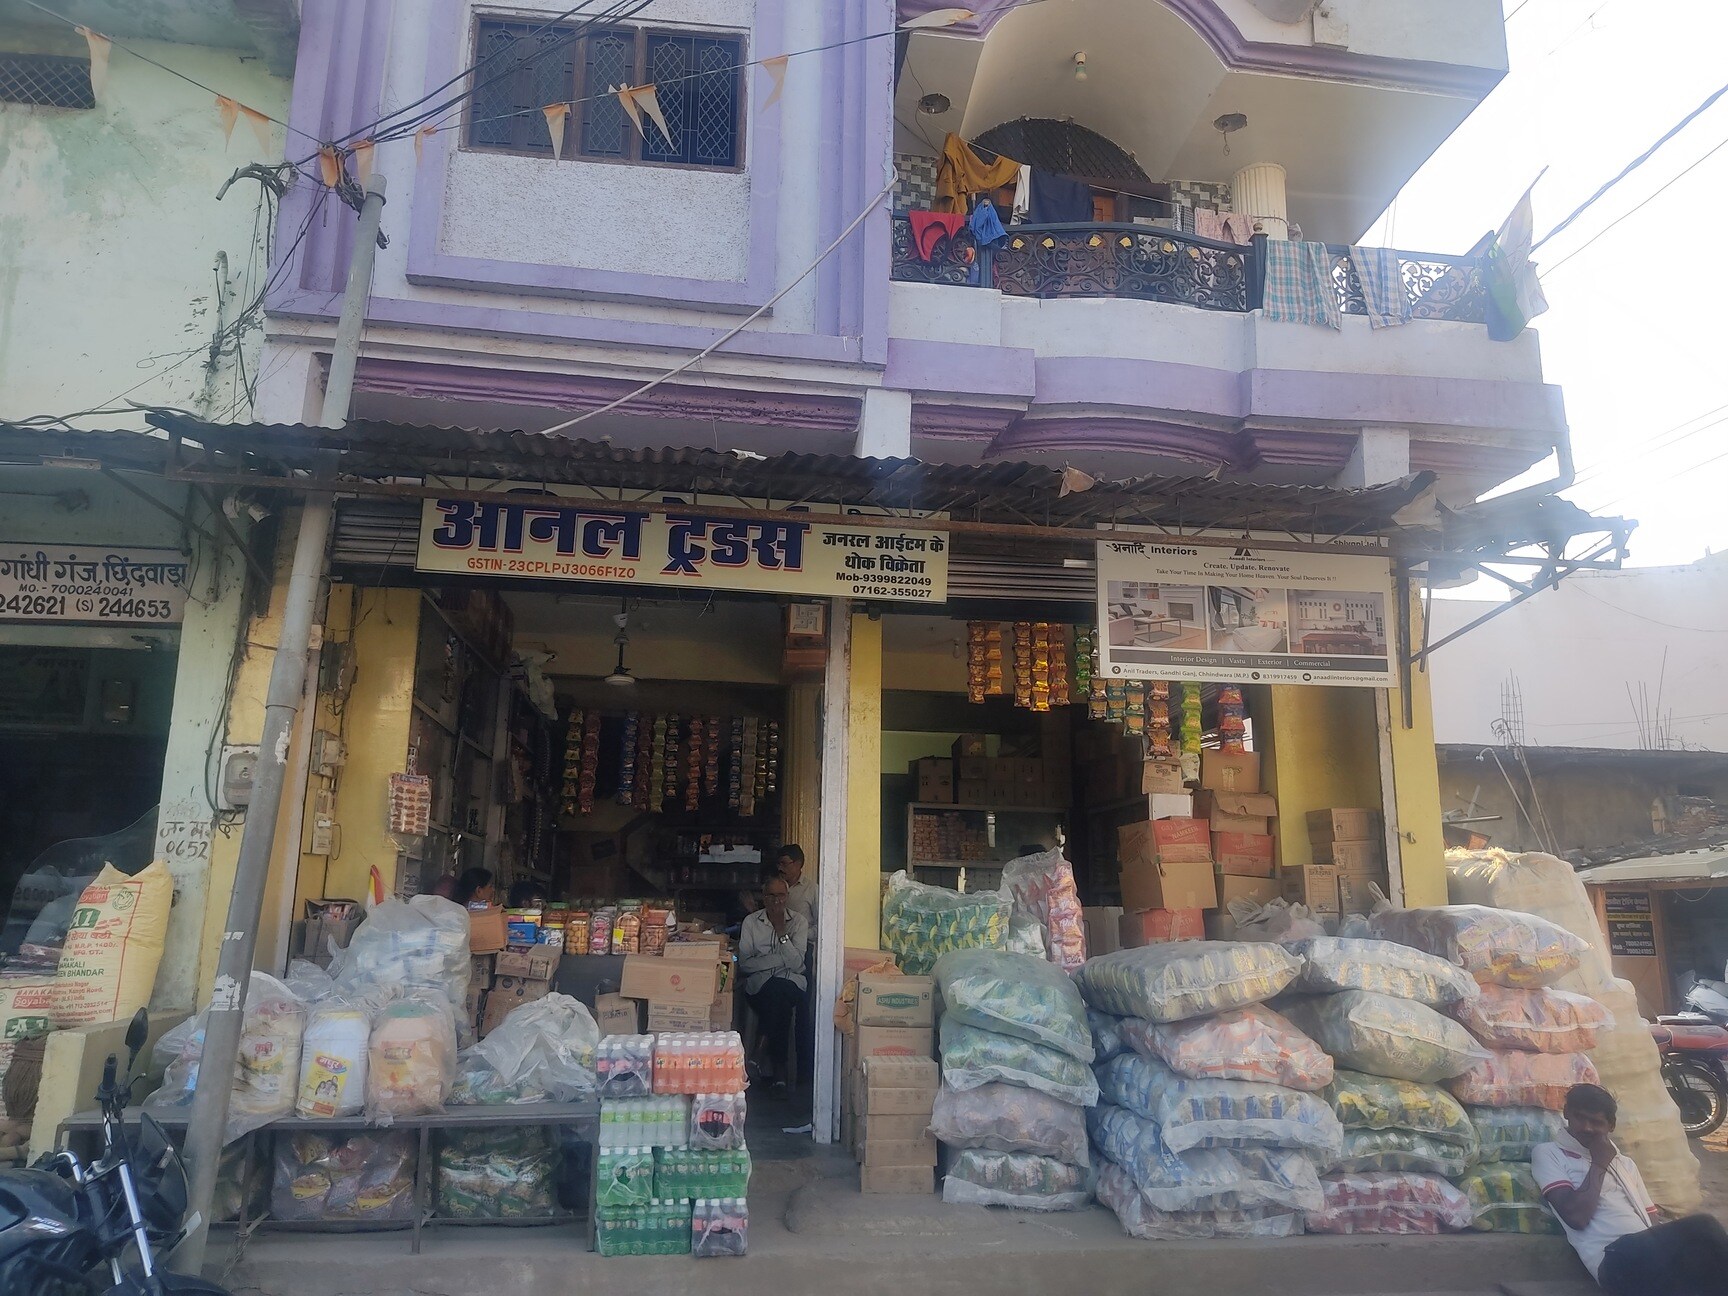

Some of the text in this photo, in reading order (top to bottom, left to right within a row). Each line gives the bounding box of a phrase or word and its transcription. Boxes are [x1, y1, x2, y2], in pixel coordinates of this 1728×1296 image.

[822, 532, 945, 554] जनरल आईटम के
[1151, 546, 1198, 556] Interiors
[0, 551, 50, 582] गांधी
[844, 552, 927, 574] थोक विक्रेता
[1230, 563, 1257, 571] Update.
[1258, 564, 1290, 572] Renovate
[835, 572, 932, 587] Mob-9399822049
[1204, 570, 1222, 578] Making
[852, 585, 932, 599] 07162-355027
[76, 598, 94, 612] (S)
[99, 597, 172, 618] 244653
[1170, 655, 1195, 663] Interior
[1195, 656, 1218, 665] Design
[166, 840, 208, 860] 0652
[68, 969, 105, 977] BHANDAR
